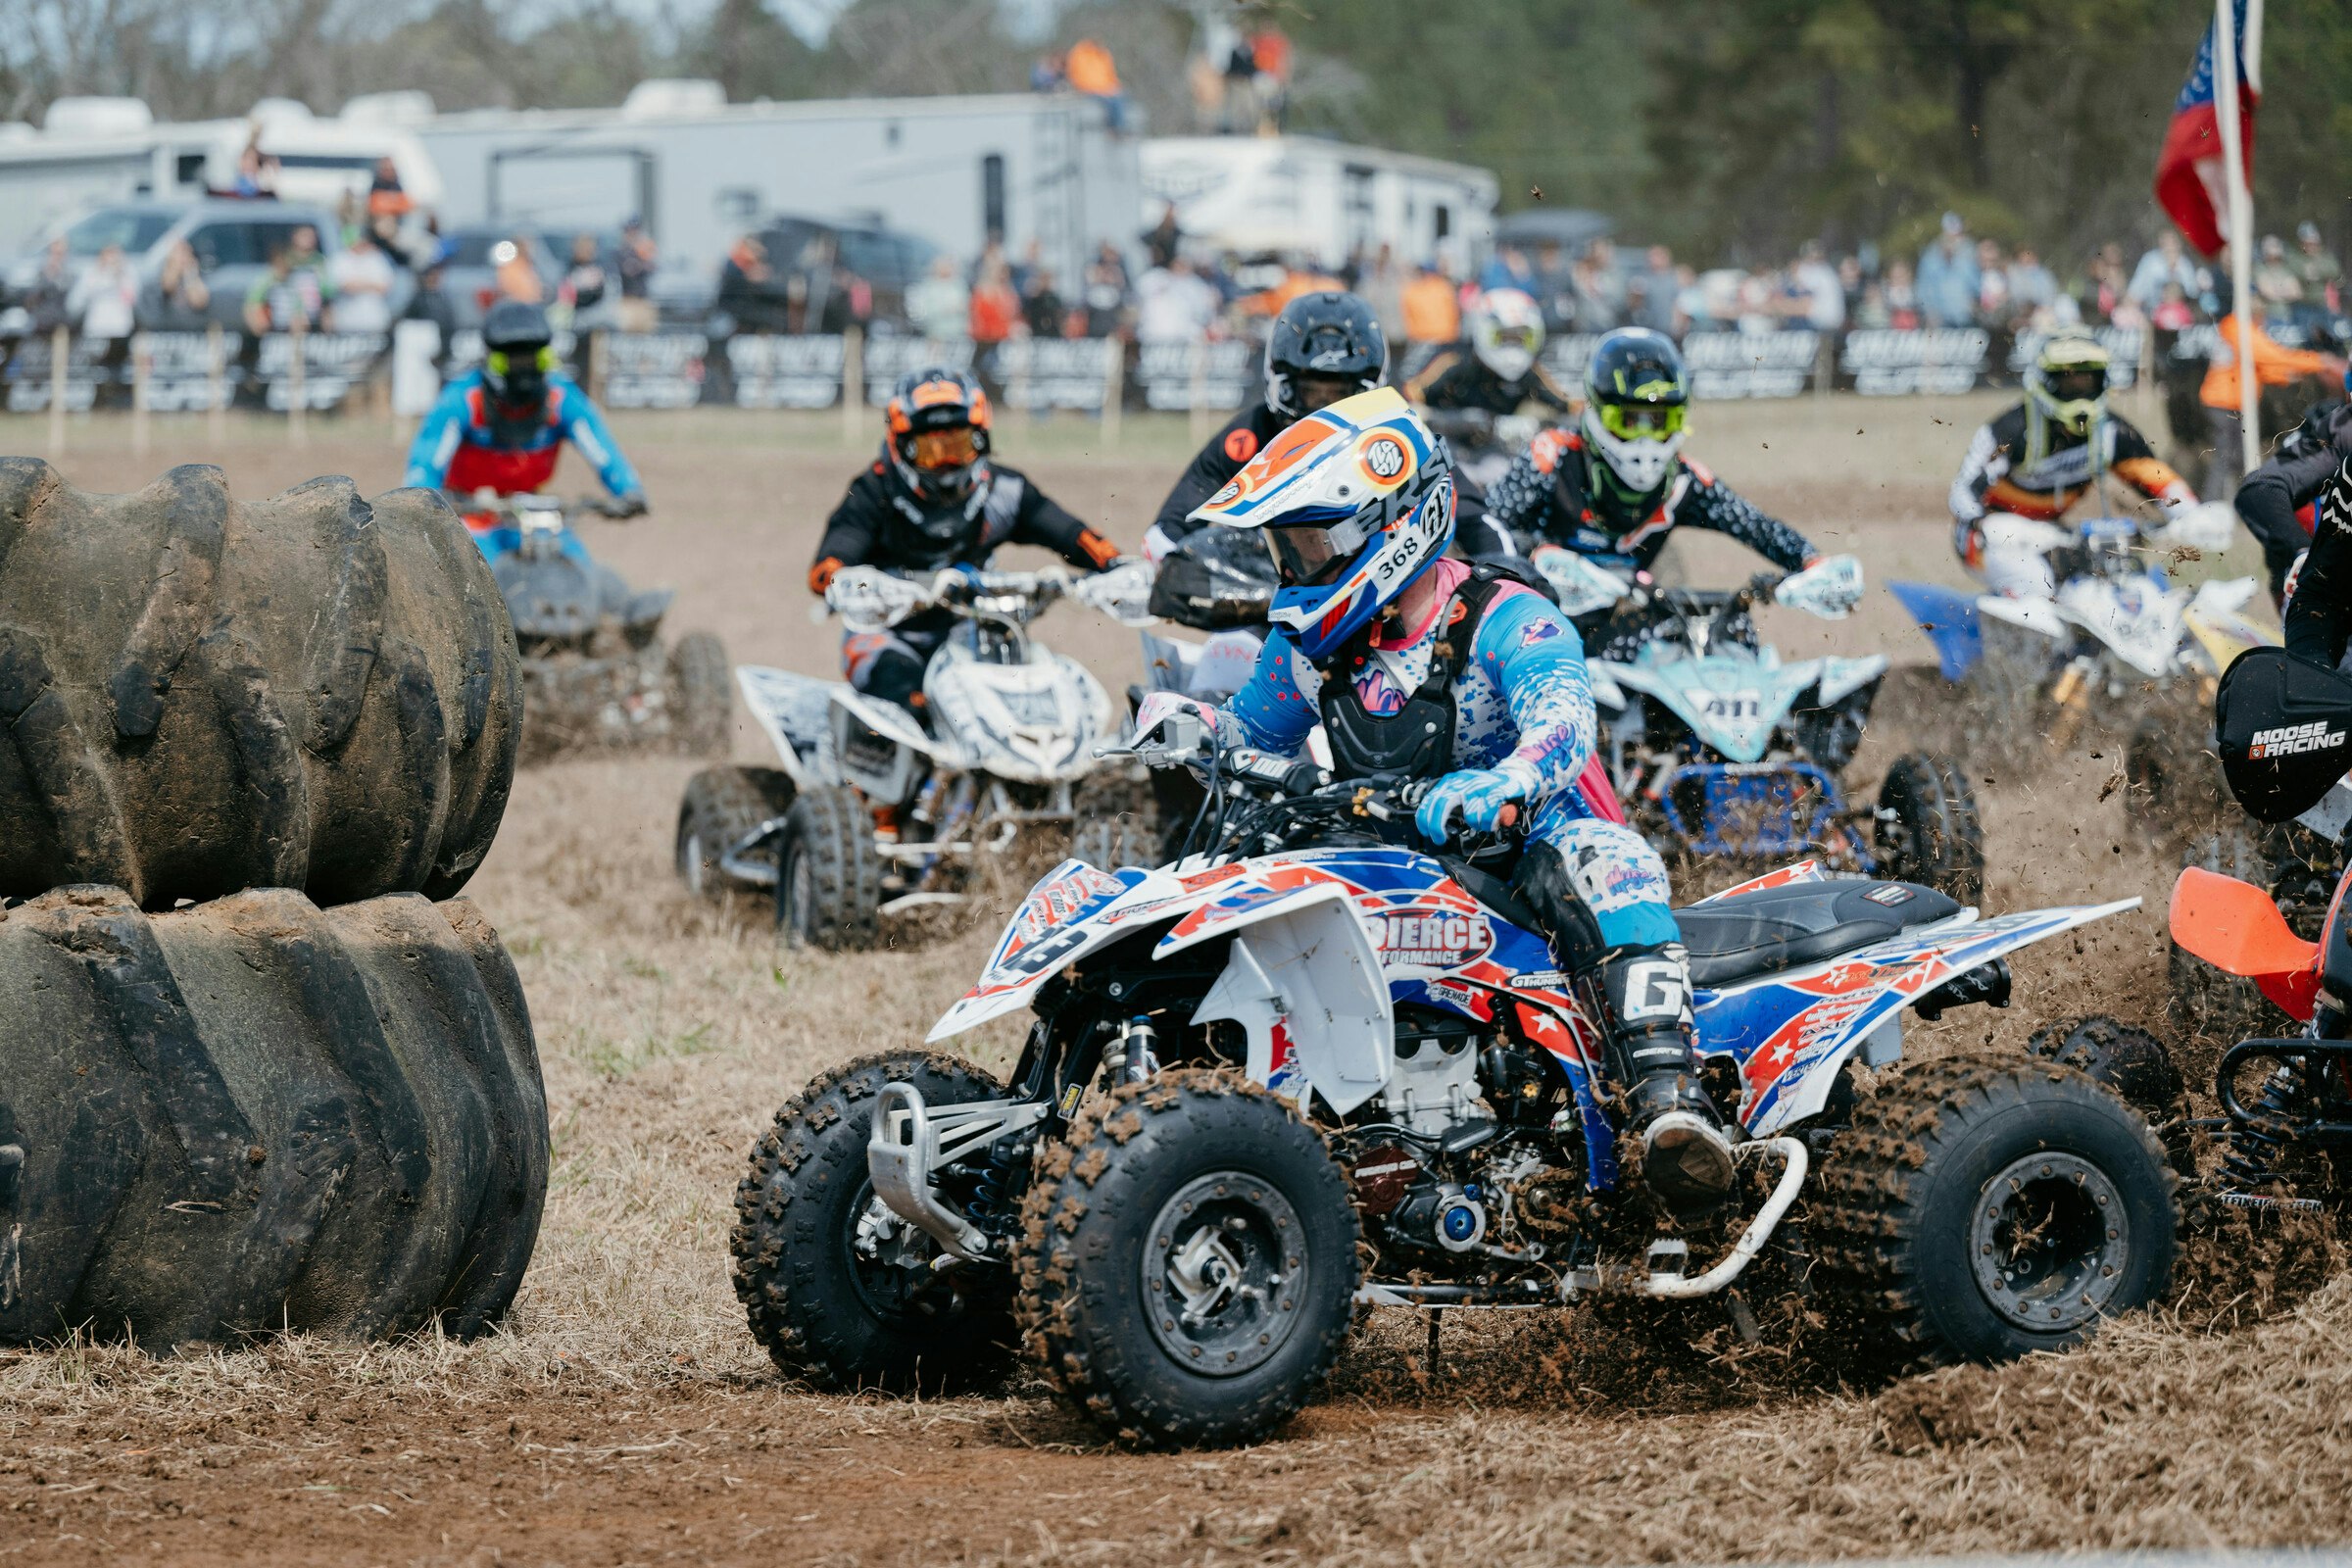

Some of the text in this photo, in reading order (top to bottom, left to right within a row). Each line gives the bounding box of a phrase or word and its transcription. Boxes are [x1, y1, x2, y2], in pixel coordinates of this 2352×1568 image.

[1378, 537, 1418, 580] 368
[2251, 720, 2328, 745] MOOSE
[2263, 731, 2346, 759] RACING
[1438, 986, 1471, 1004] GRENADE
